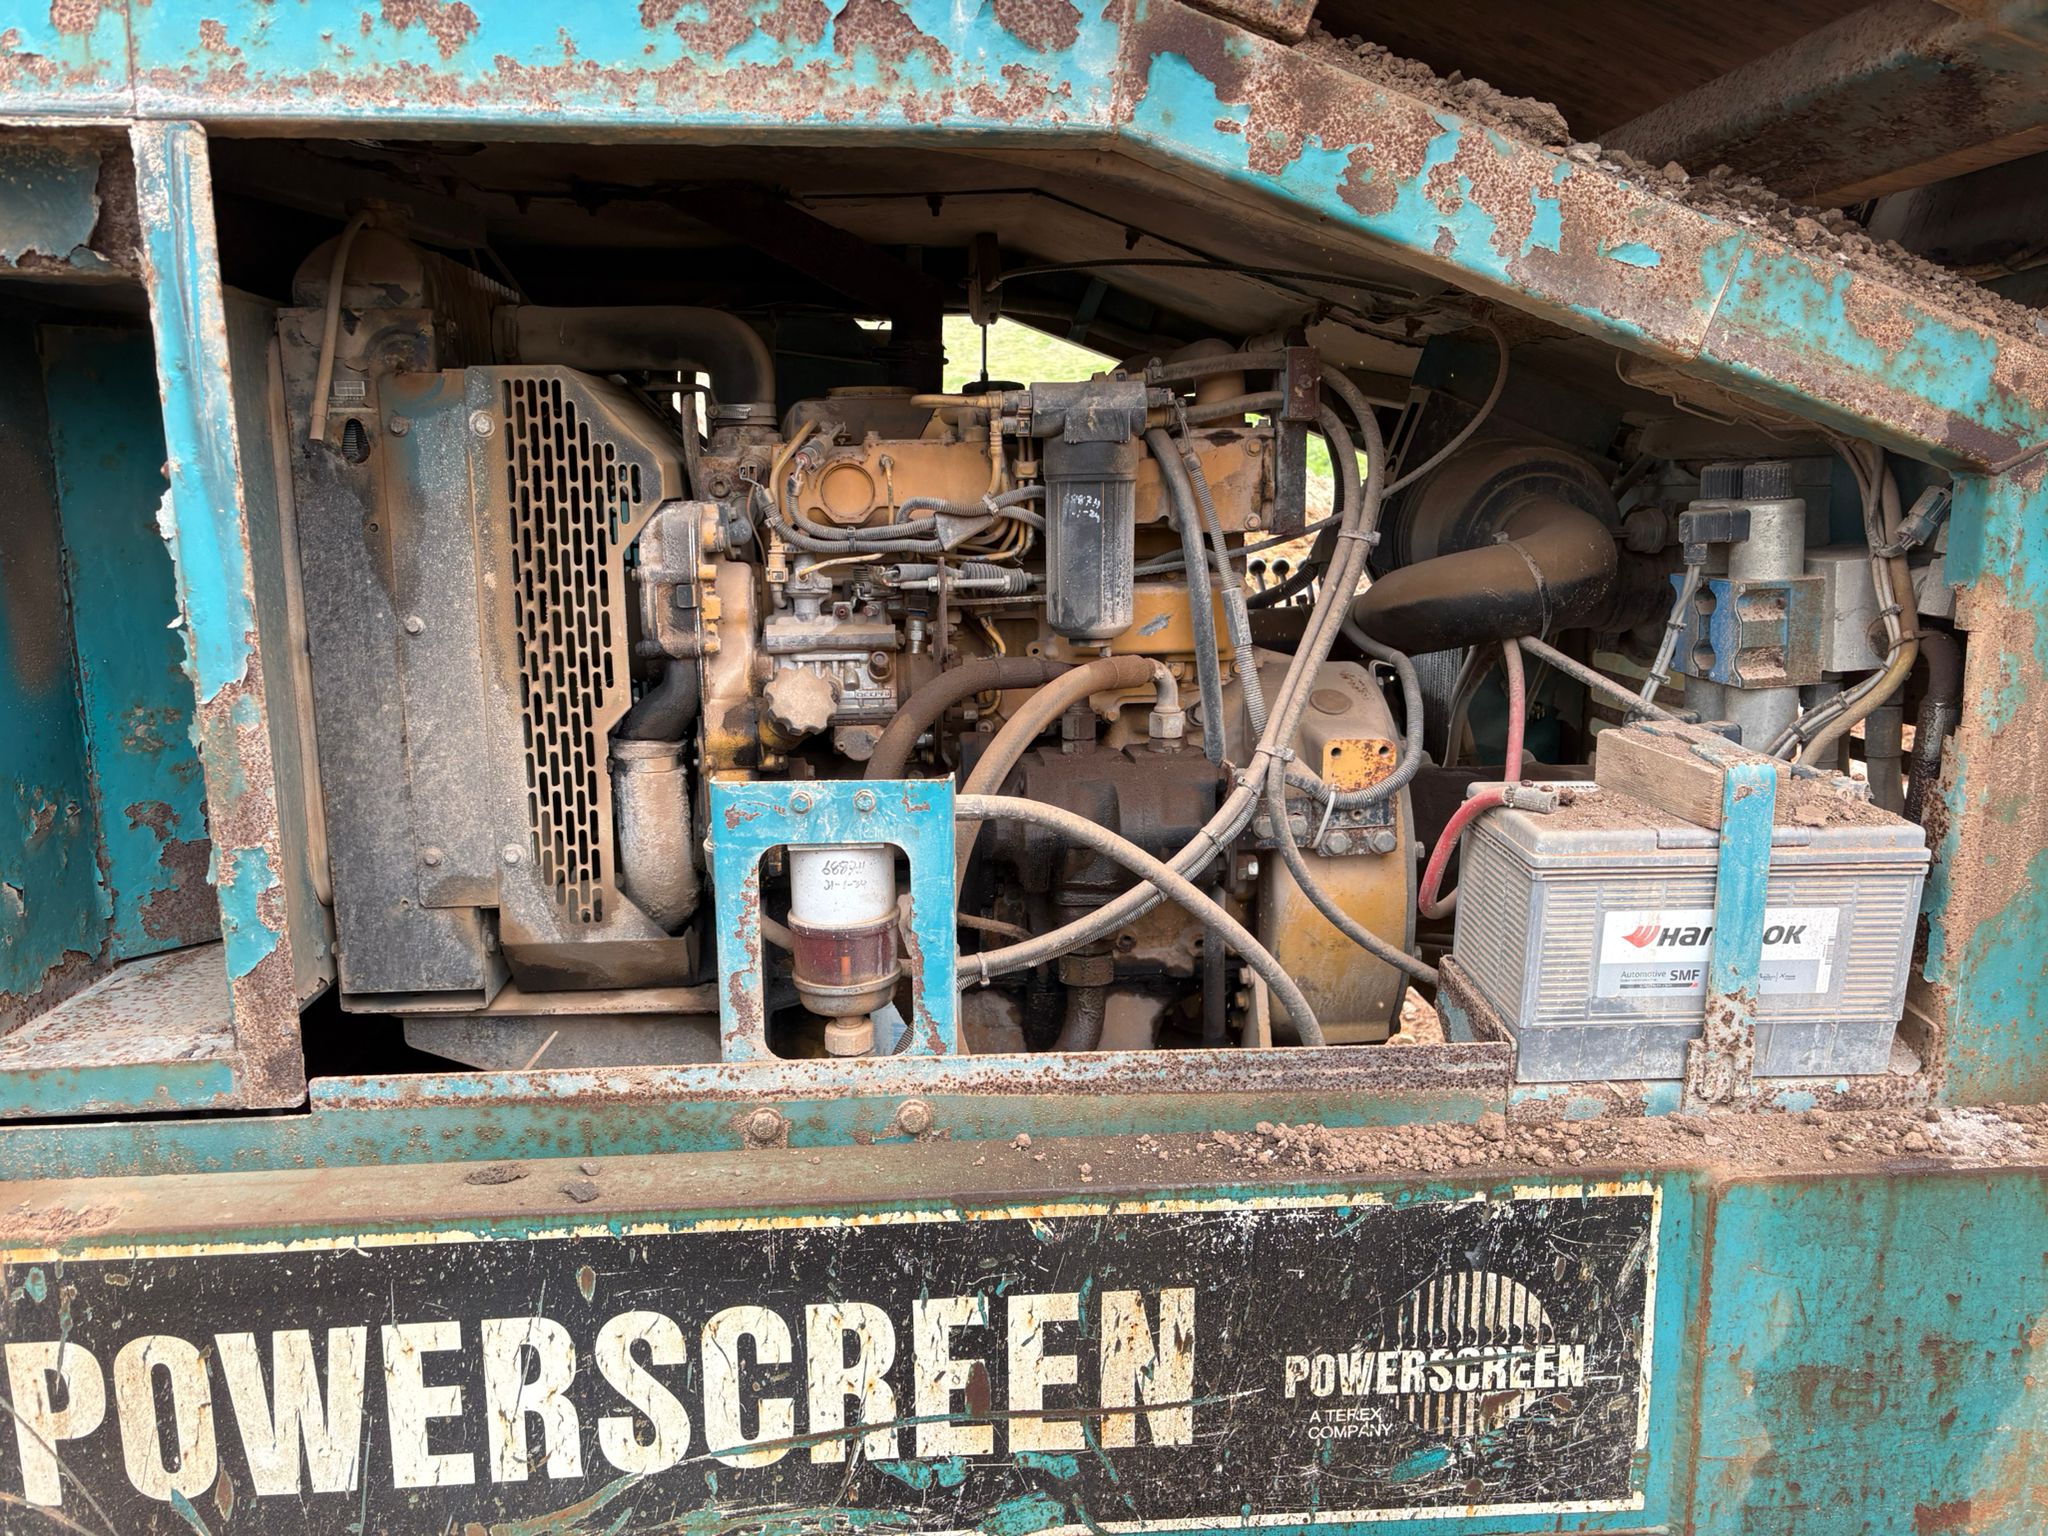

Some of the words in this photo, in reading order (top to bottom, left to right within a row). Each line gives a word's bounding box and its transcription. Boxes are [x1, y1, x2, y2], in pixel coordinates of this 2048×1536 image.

[1620, 969, 1667, 978] Automotive
[1669, 969, 1700, 981] SMF
[1284, 1343, 1586, 1399] POWERSCREEN
[4, 1287, 1196, 1507] POWERSCREEN
[1309, 1409, 1322, 1424] A
[1325, 1406, 1382, 1423] TEREX
[1308, 1422, 1394, 1440] COMPANY
